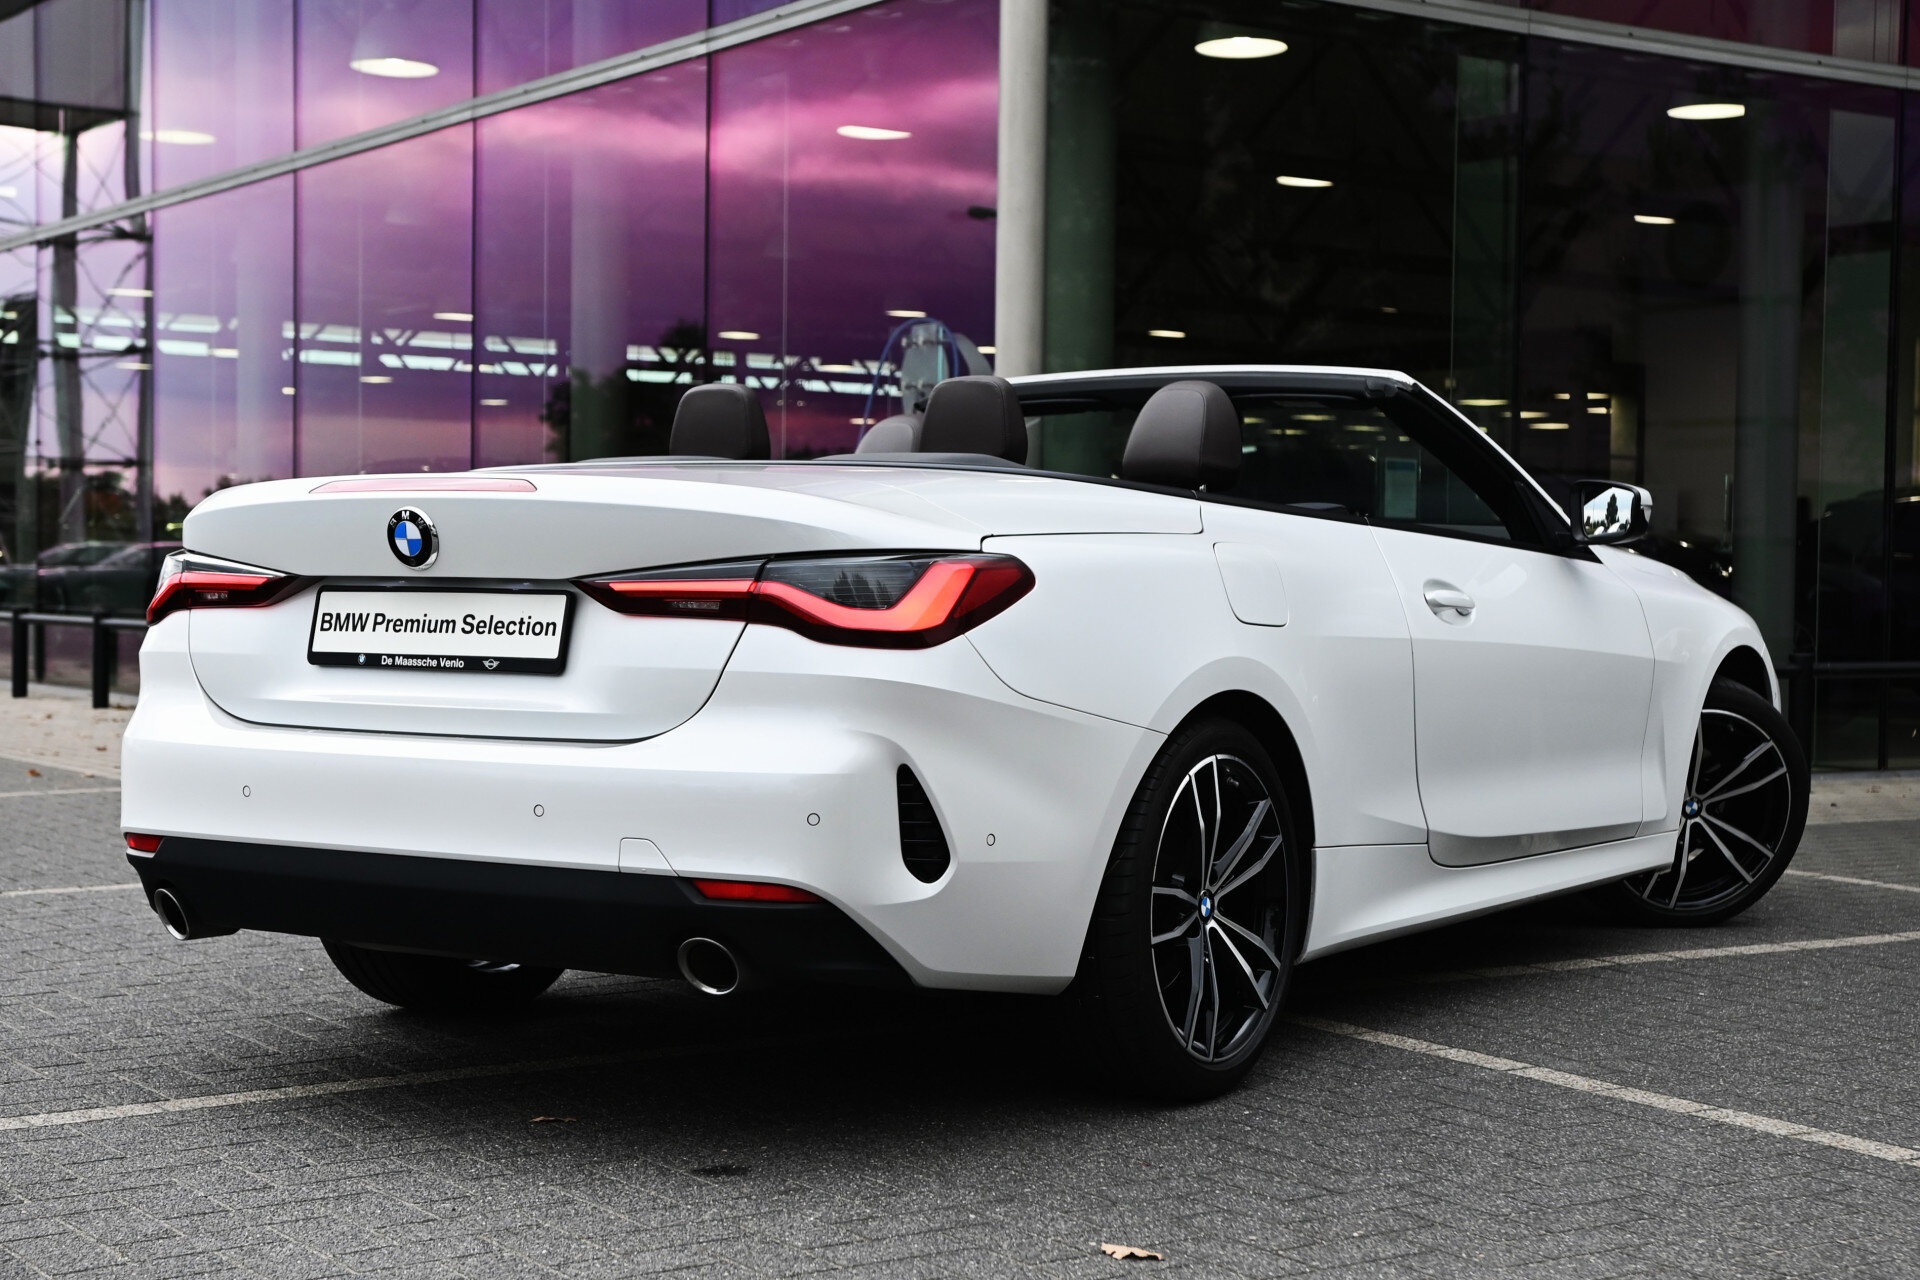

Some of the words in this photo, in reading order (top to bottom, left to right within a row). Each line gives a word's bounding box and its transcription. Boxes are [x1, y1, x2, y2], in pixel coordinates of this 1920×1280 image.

[319, 612, 370, 632] BMW
[372, 613, 457, 634] Premium
[461, 613, 557, 637] Selection
[381, 655, 393, 666] De
[394, 655, 438, 667] Maassche
[439, 657, 465, 669] Venlo
